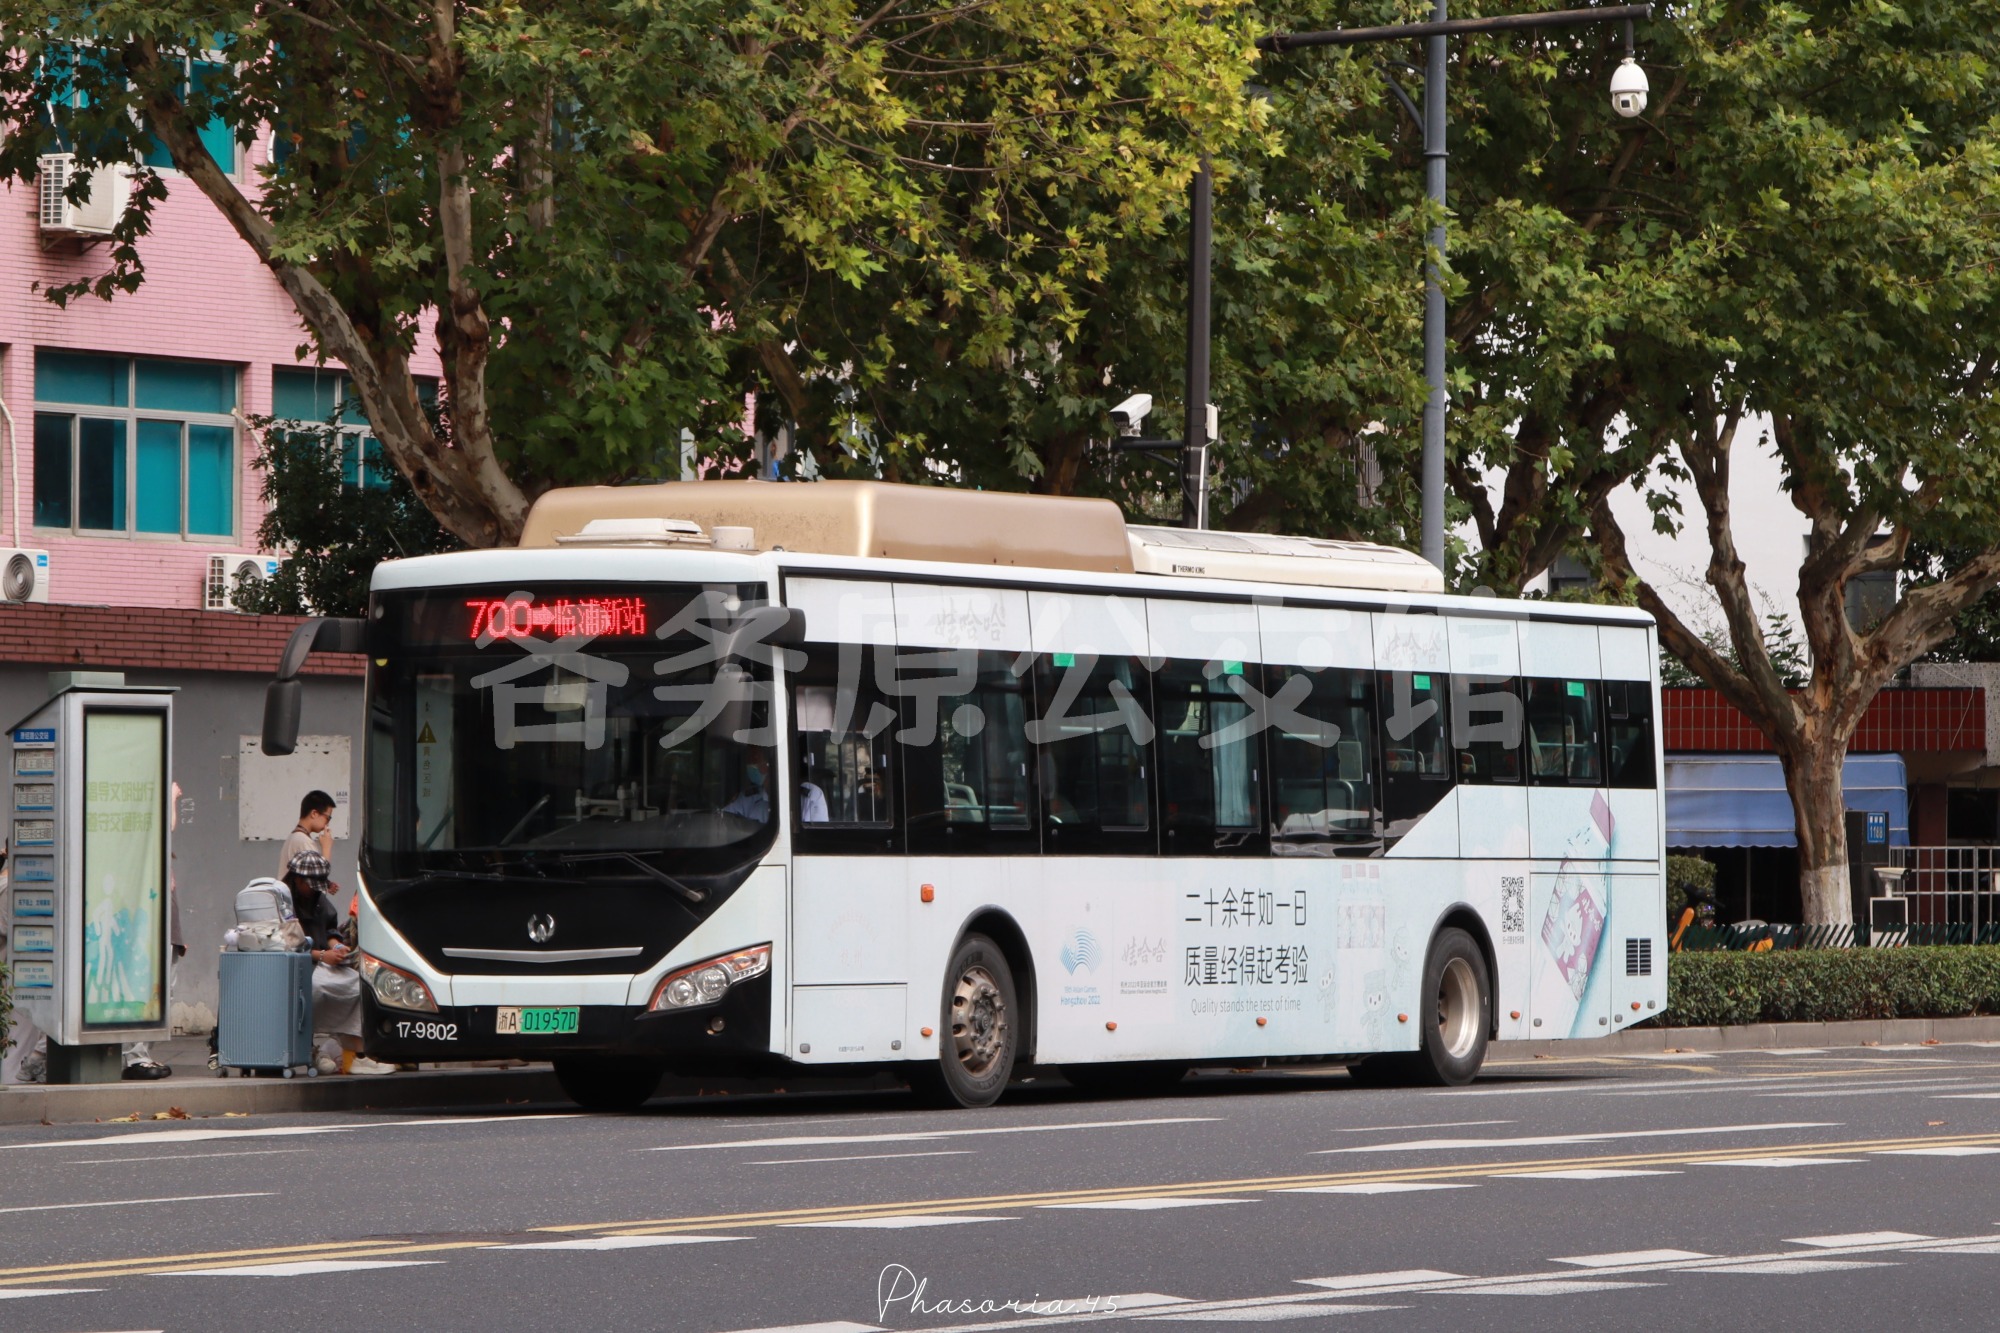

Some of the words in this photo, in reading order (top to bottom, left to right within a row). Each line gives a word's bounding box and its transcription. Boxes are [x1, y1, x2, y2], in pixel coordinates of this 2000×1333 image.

[1178, 565, 1194, 573] THERMO
[466, 601, 533, 638] 700
[554, 598, 646, 636] 临浦新站
[1185, 887, 1307, 928] 二十余年如一日
[1121, 936, 1166, 966] 娃哈哈
[1184, 945, 1309, 986] 质量经得起考验
[1191, 998, 1218, 1016] Quality
[1220, 997, 1245, 1013] stands
[1246, 998, 1259, 1012] the
[1260, 998, 1274, 1012] test
[1275, 995, 1285, 1010] of
[1284, 996, 1302, 1010] time
[396, 1021, 458, 1041] 17-9802
